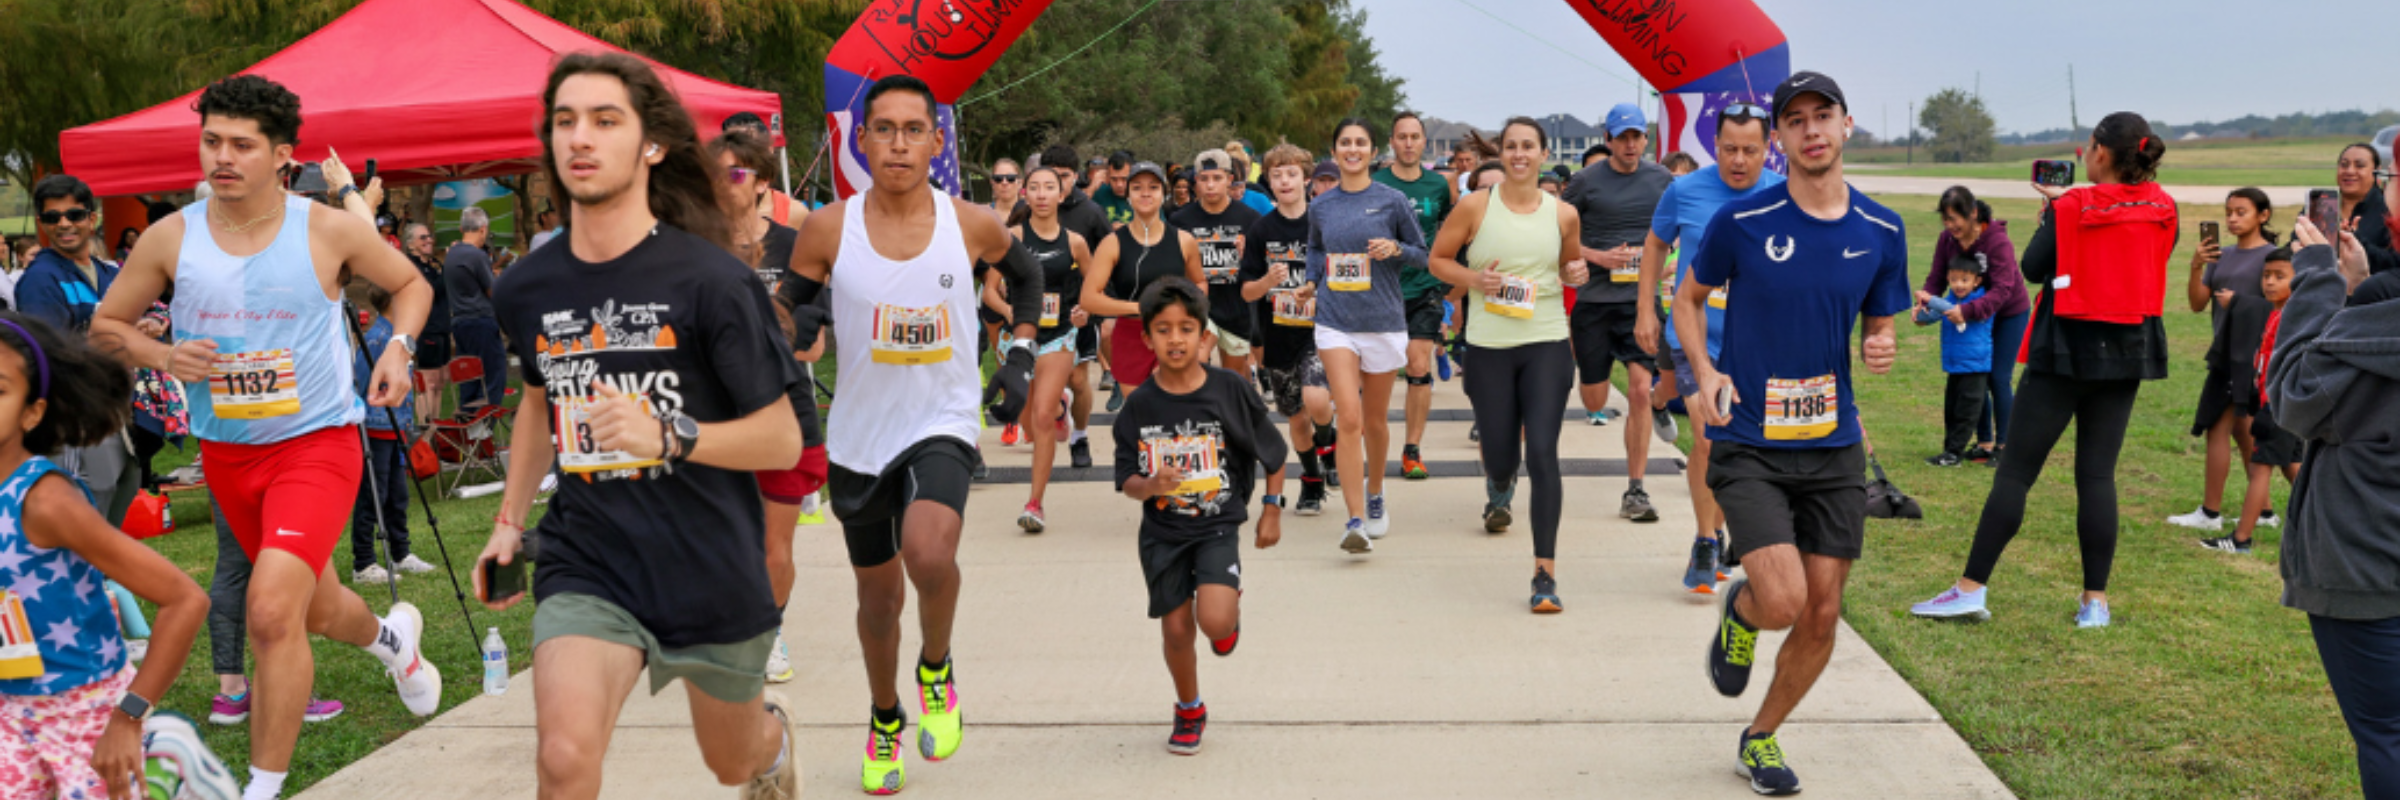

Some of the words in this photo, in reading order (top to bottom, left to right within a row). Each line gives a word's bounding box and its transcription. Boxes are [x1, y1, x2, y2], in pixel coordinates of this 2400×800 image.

[891, 323, 935, 345] 450
[222, 369, 280, 396] 1132
[1781, 394, 1826, 419] 1136
